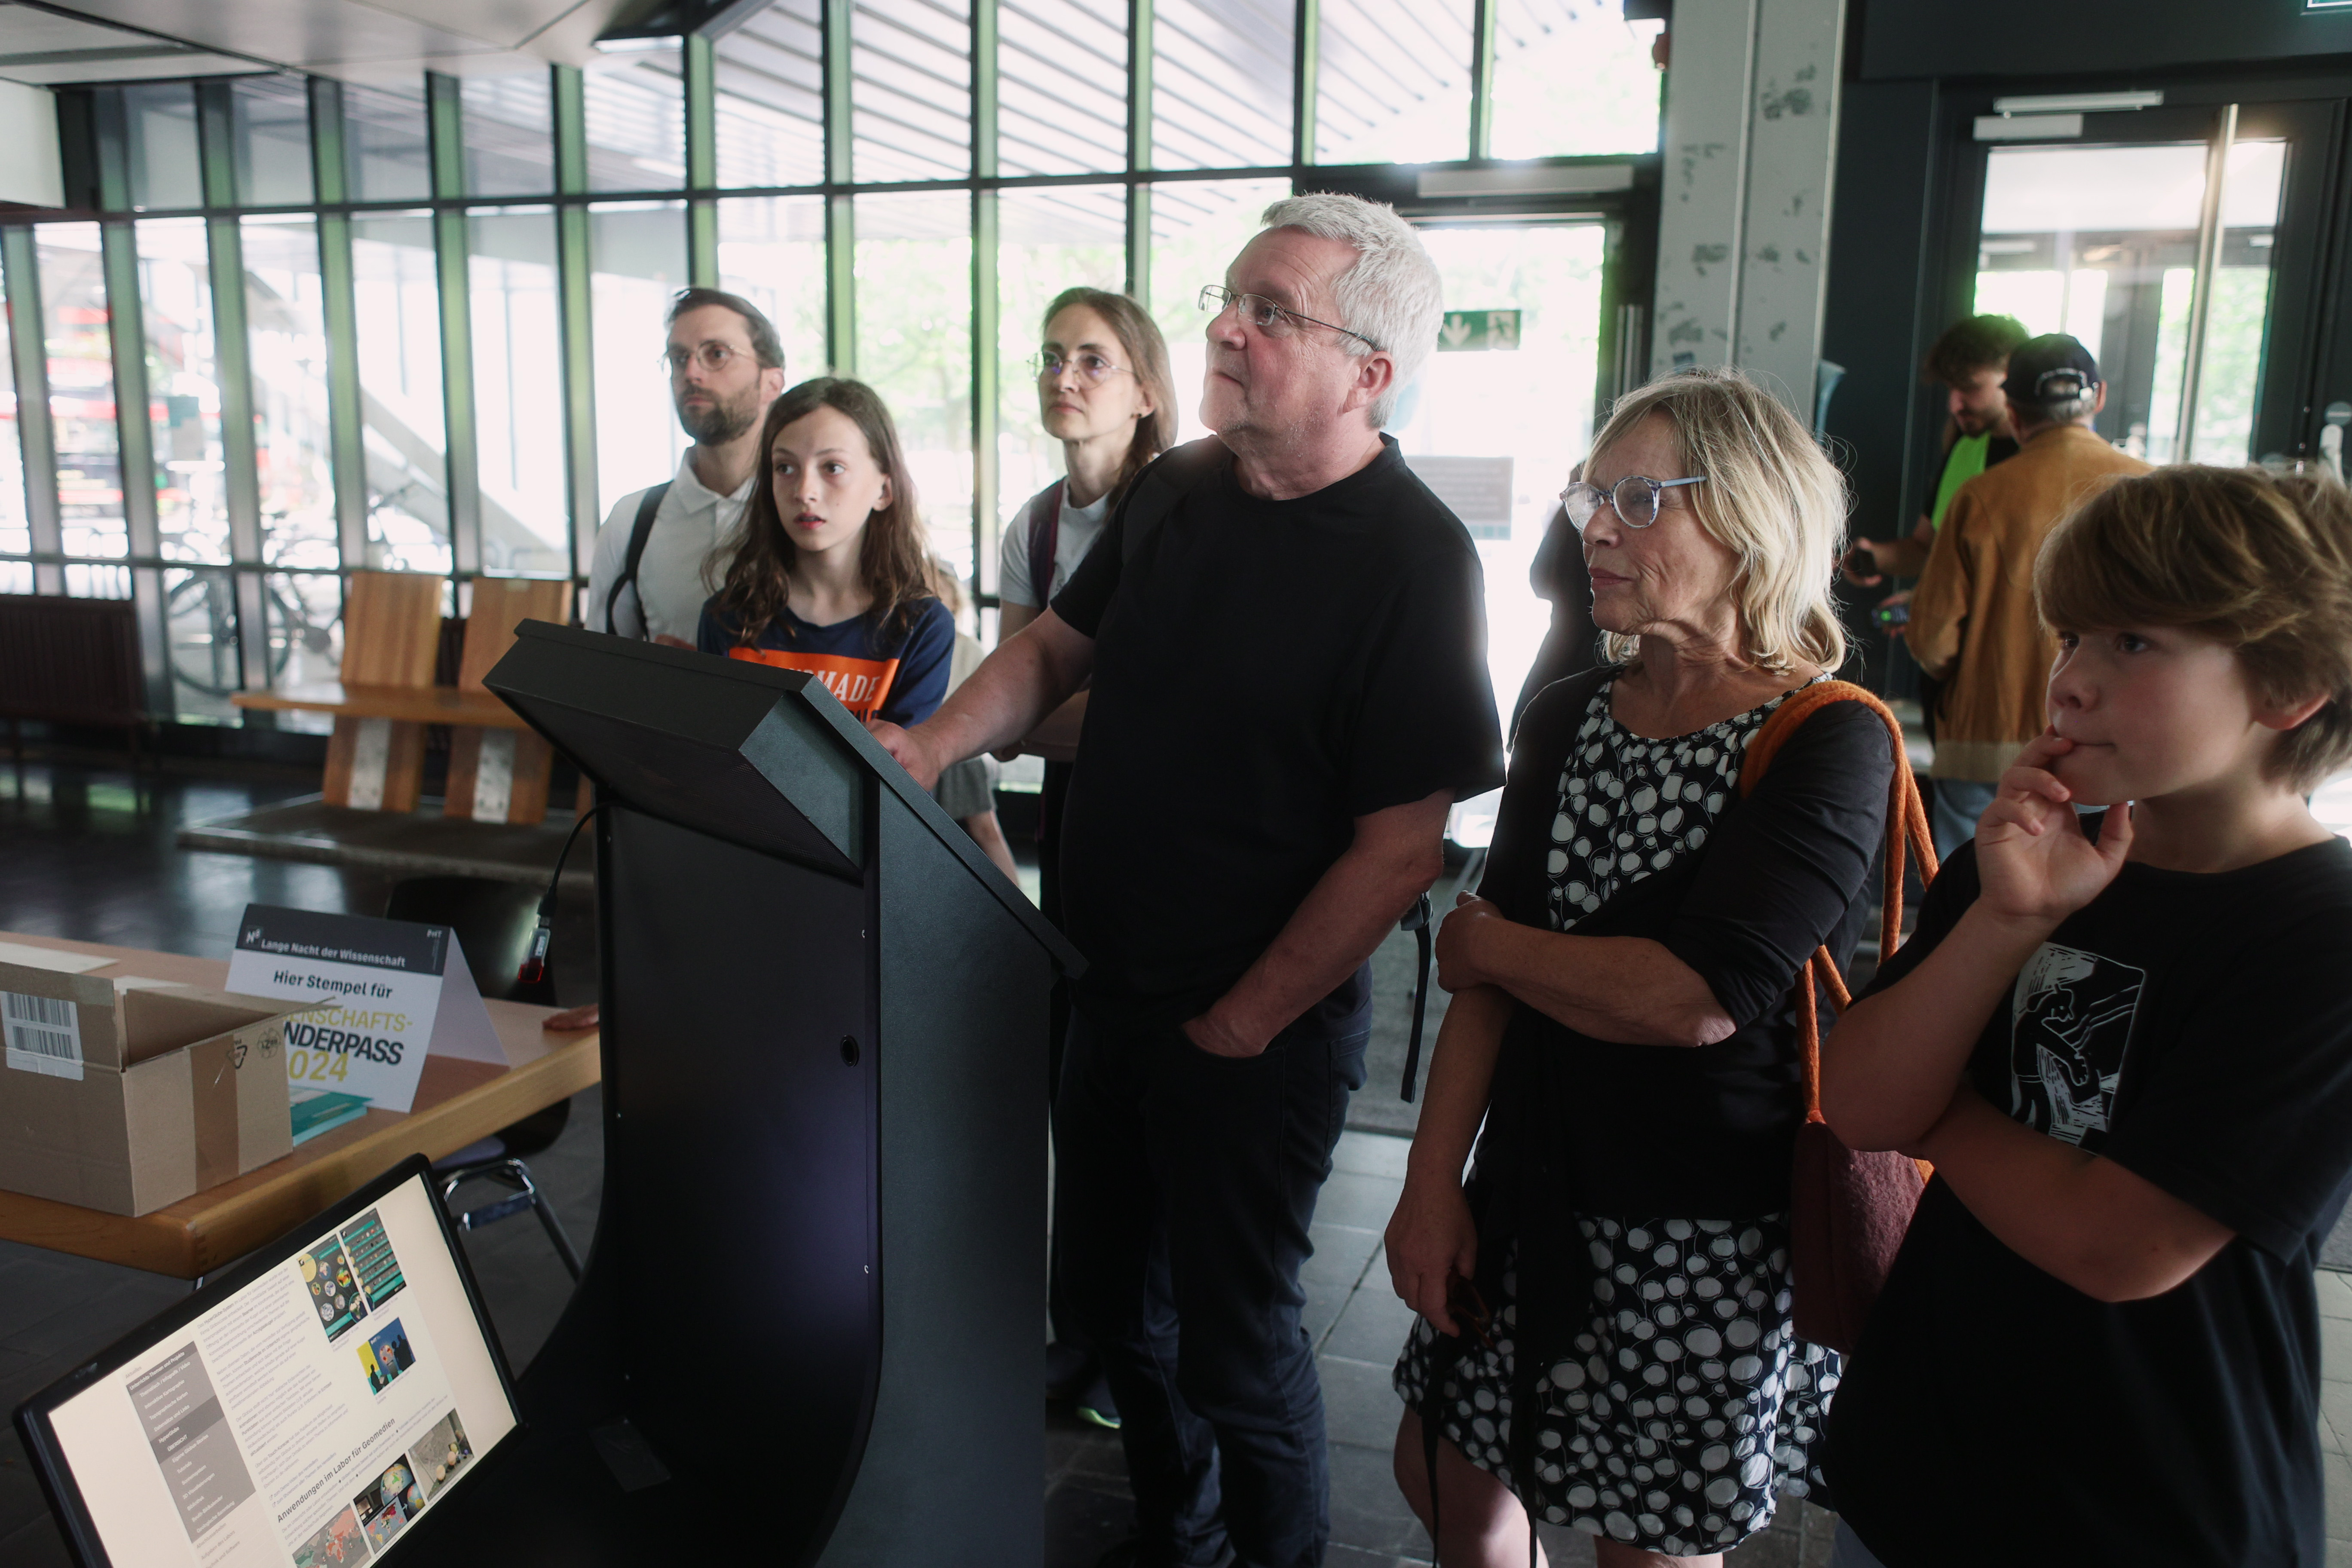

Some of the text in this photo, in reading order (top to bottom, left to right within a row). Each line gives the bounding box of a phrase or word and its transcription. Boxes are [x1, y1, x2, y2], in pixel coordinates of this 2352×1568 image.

[788, 668, 881, 702] MADE
[261, 938, 405, 967] Lange Nacht der Wissenschaft
[274, 970, 393, 998] Hier Stempel für
[277, 1417, 395, 1523] Anwendungen im Labor für Geomedien
